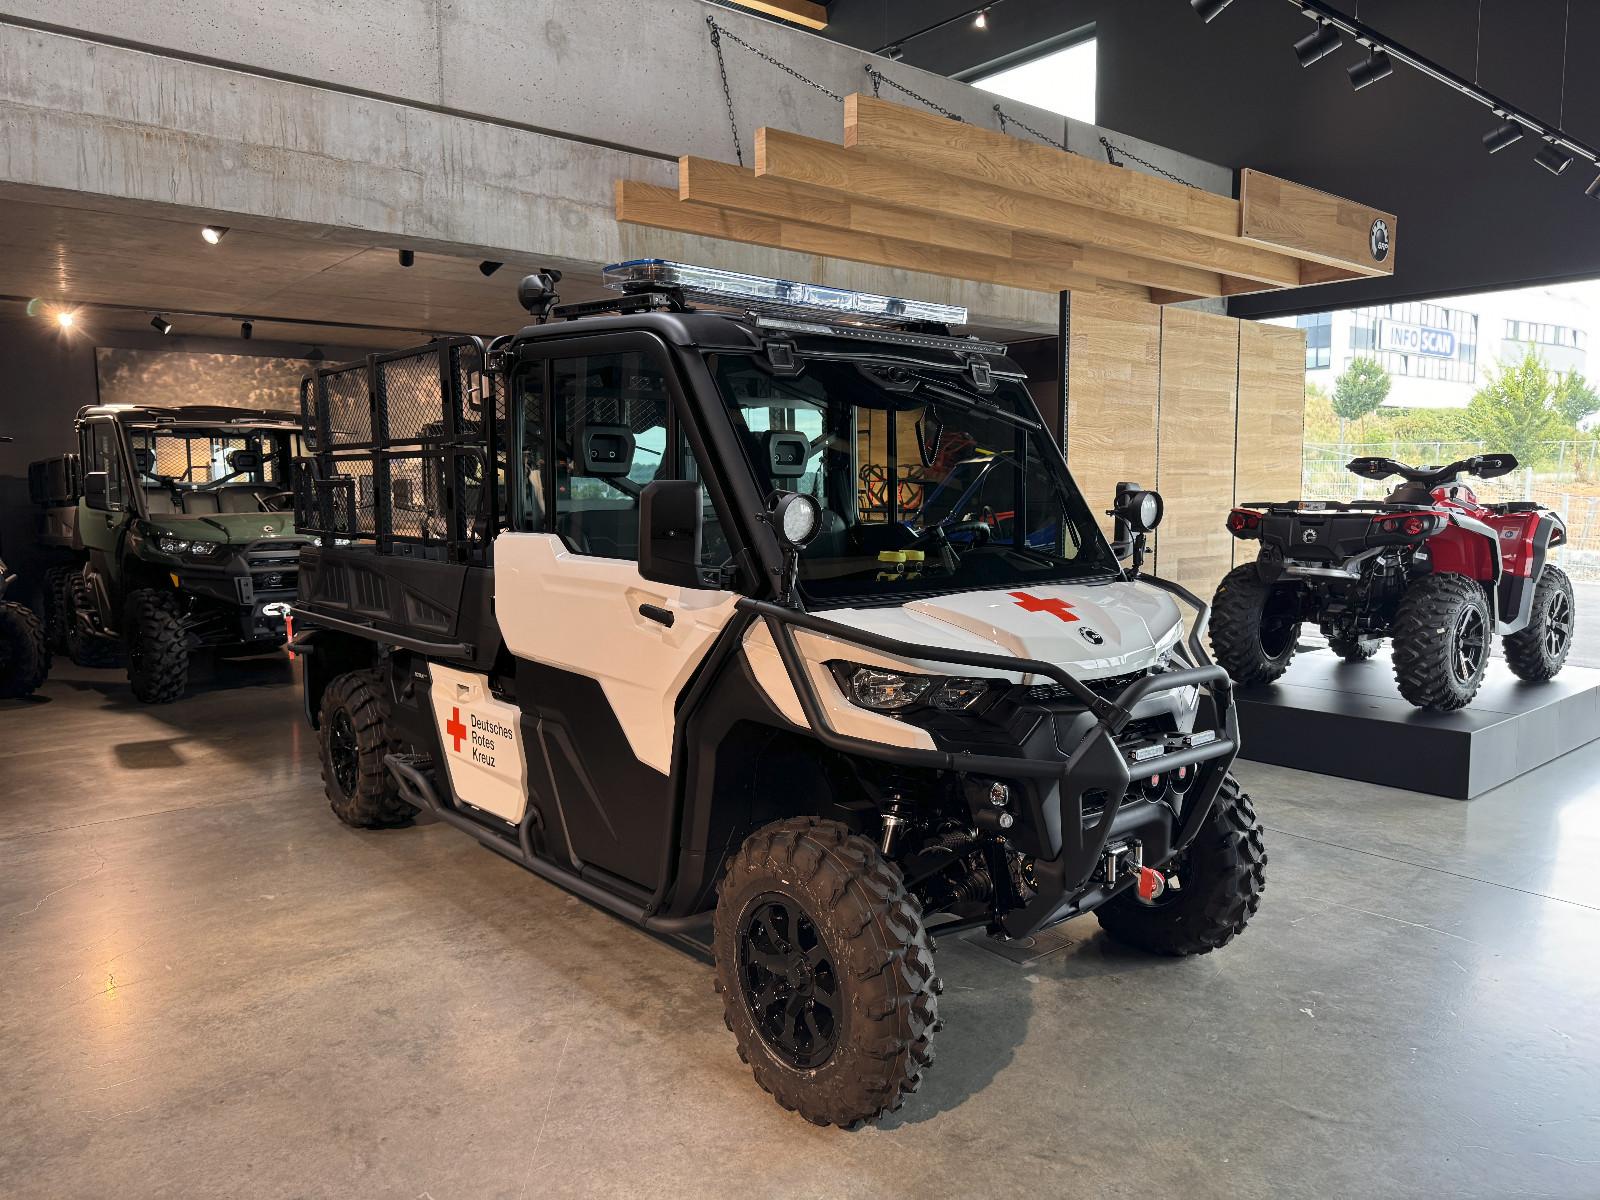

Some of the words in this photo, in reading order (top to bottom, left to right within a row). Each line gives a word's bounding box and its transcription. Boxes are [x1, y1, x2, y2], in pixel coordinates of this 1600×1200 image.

[1390, 326, 1418, 348] INFO
[1421, 331, 1452, 354] SCAN
[470, 713, 513, 740] Deutsches
[471, 730, 495, 751] Rotes
[472, 746, 496, 768] Kreuz
